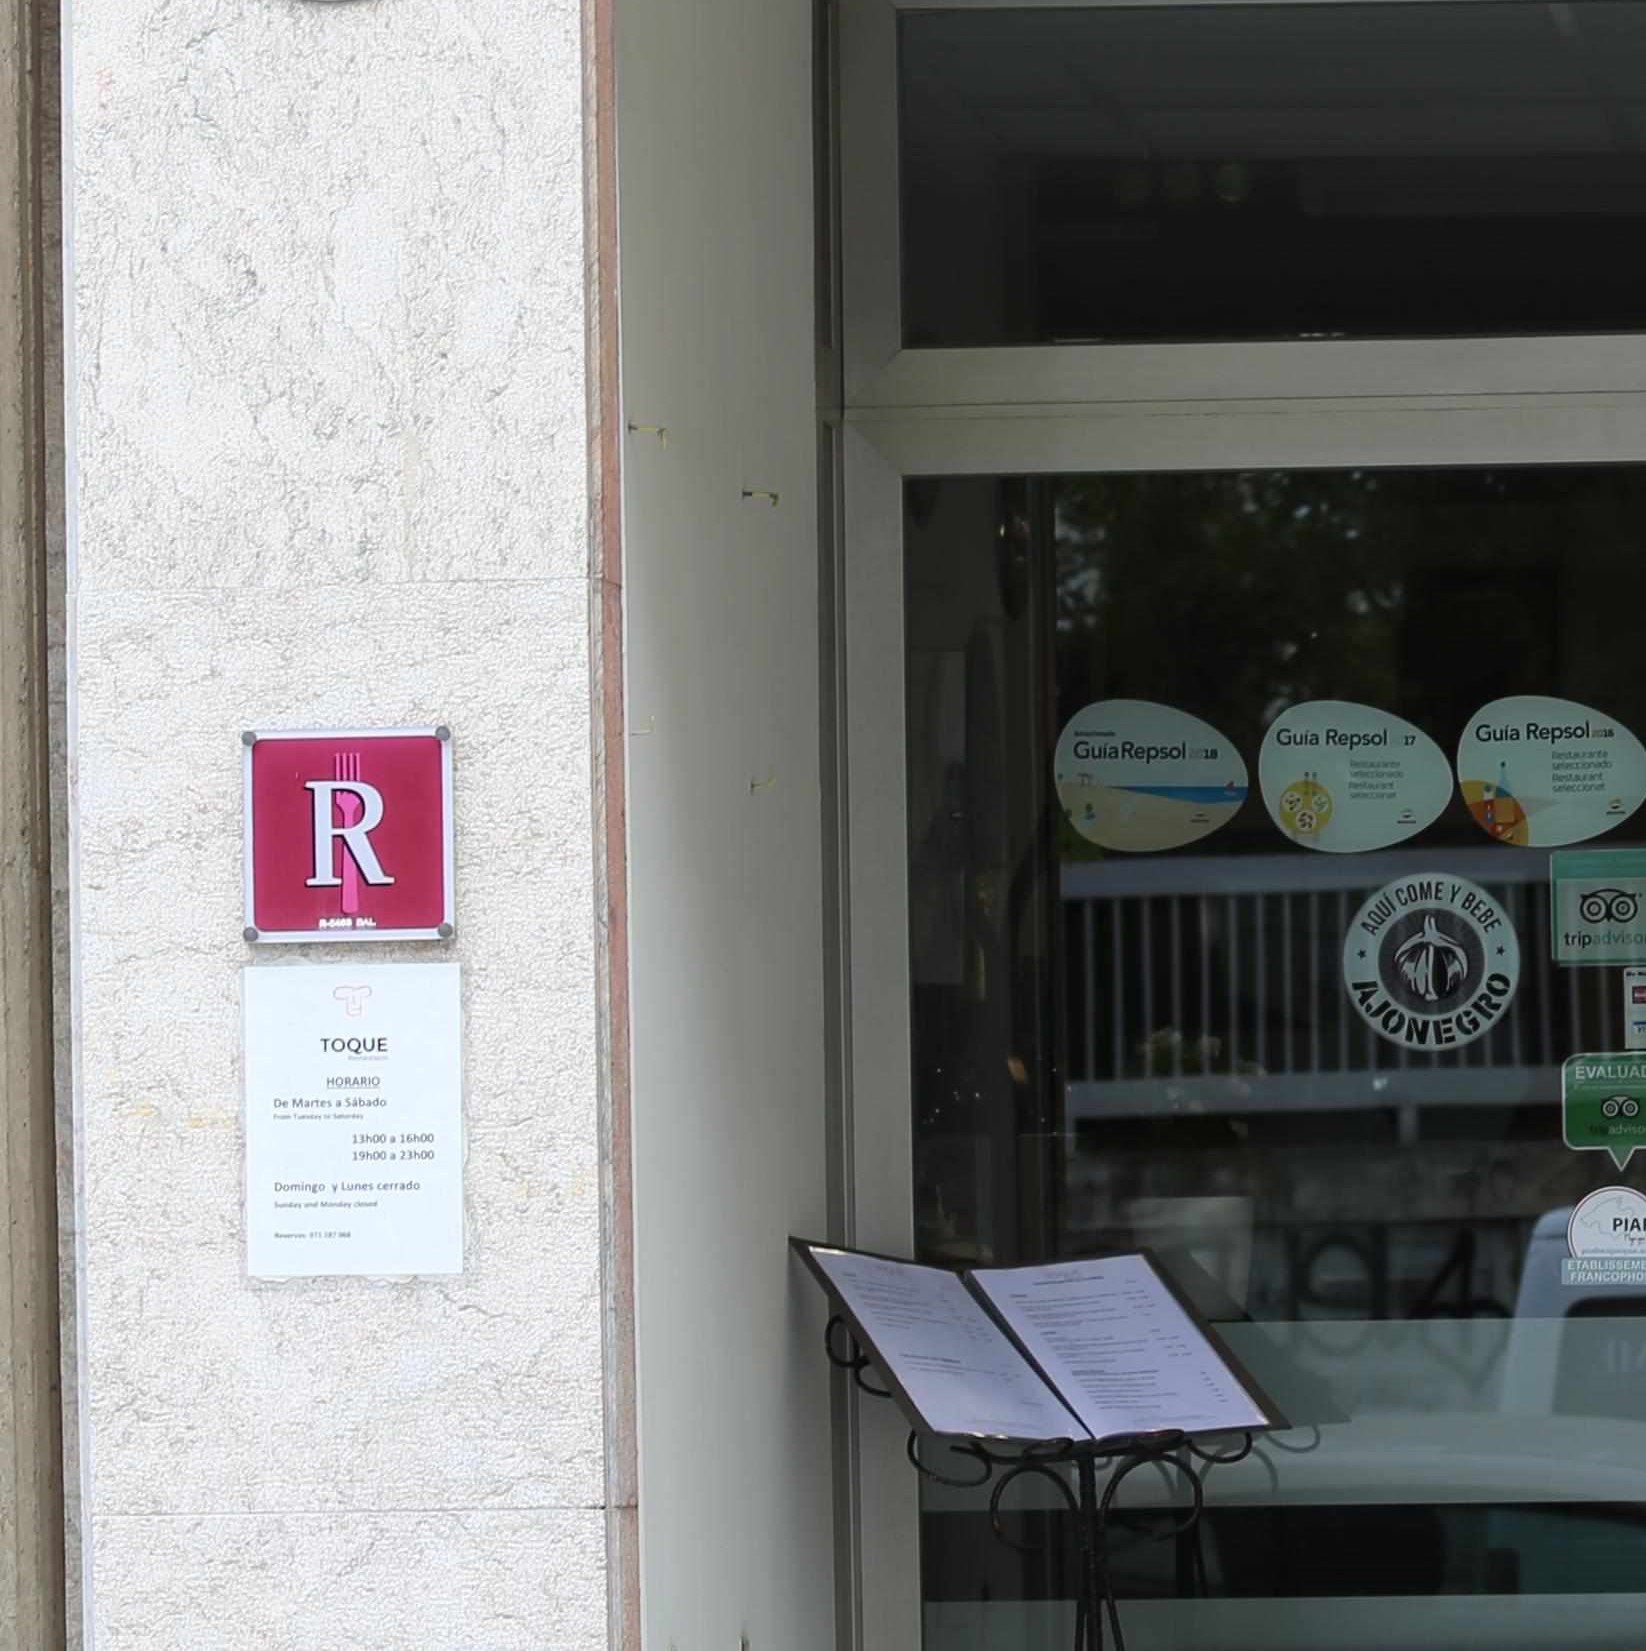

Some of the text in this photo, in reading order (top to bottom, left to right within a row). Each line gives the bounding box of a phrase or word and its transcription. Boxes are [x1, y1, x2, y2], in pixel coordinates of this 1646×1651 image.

[1276, 728, 1320, 746] Guía
[1326, 728, 1387, 750] Repsol
[1475, 724, 1520, 743] Guía
[1526, 719, 1590, 744] Repsol
[304, 780, 395, 886] R
[1361, 881, 1502, 936] AQUÍ COME Y BEBE
[1352, 973, 1511, 1045] AJONEGRO
[320, 1037, 388, 1054] TOQUE
[326, 1076, 380, 1087] HORARIO
[273, 1096, 387, 1109] De Martes a Sábado
[352, 1133, 434, 1144] 13h00 a 16h00
[352, 1150, 434, 1161] 19h00 a 23h00
[274, 1180, 421, 1195] Domingo y Lunes cerrado
